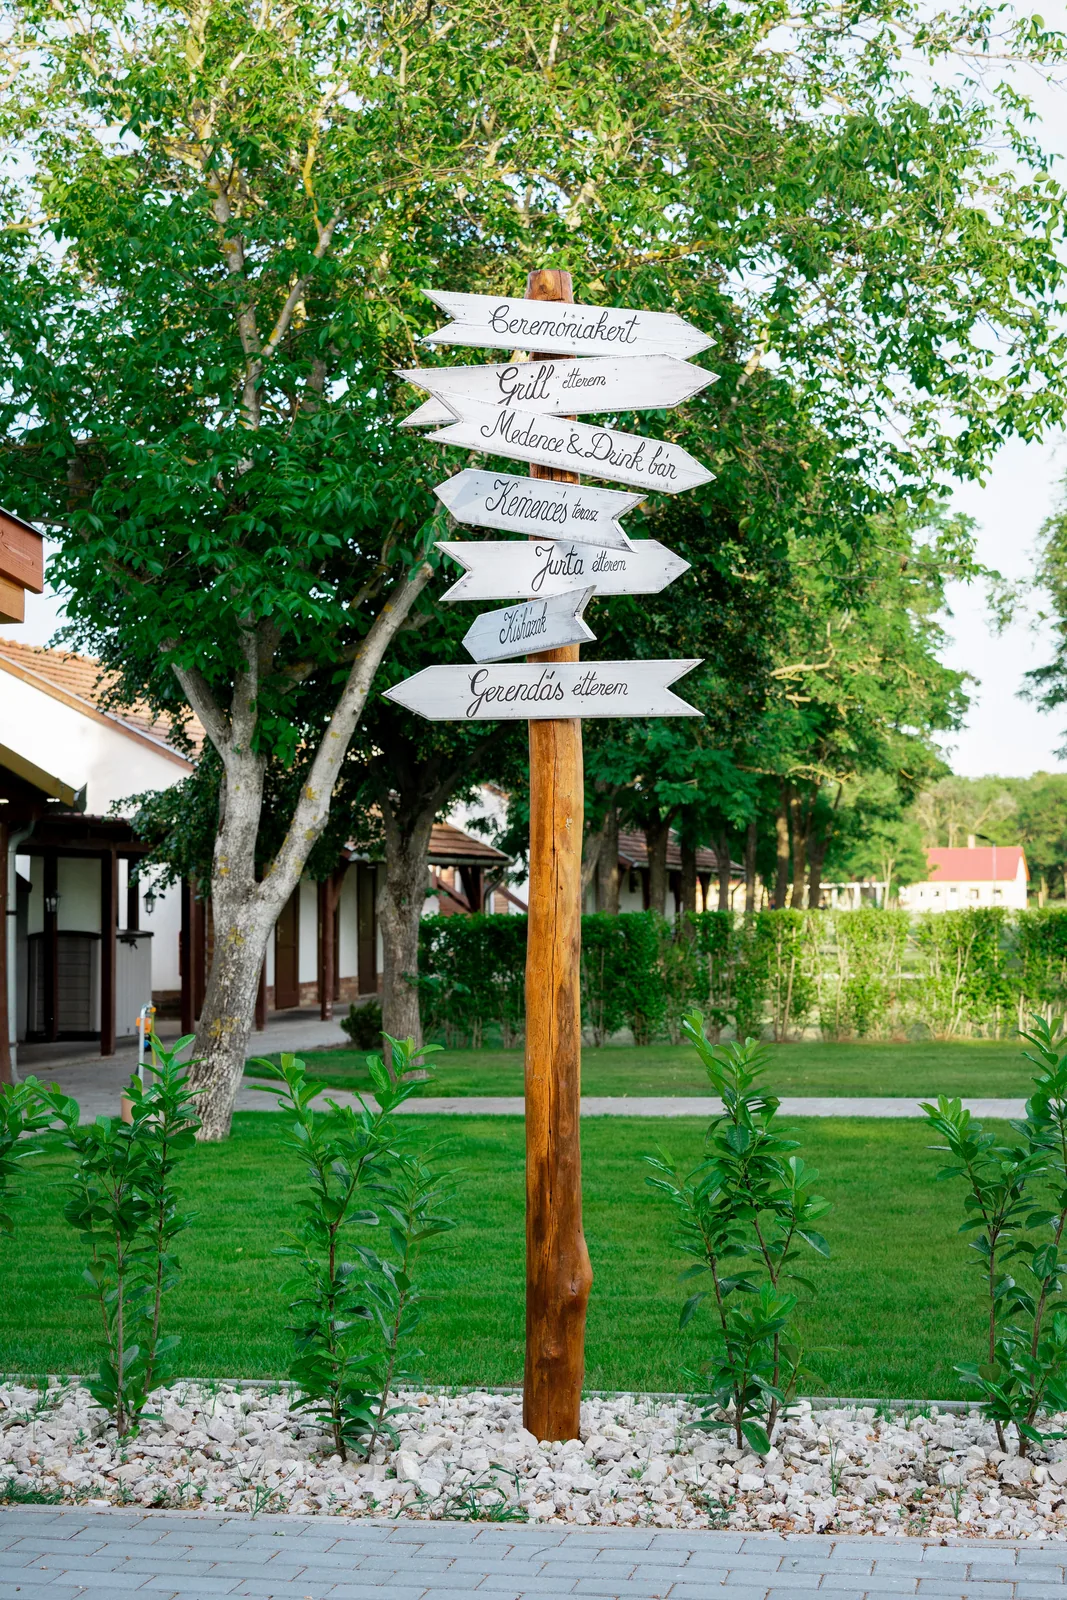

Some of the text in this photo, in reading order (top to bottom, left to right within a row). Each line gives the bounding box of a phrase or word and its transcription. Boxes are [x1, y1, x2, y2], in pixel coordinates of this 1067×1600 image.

[488, 304, 641, 344] Ceremóniakert
[495, 364, 606, 406] Grill étterem
[480, 409, 678, 480] Medence & Drink bár
[485, 479, 599, 524] Kemencés terasz
[531, 545, 627, 592] Jurta étterem
[466, 668, 628, 718] Gerendás étterem
